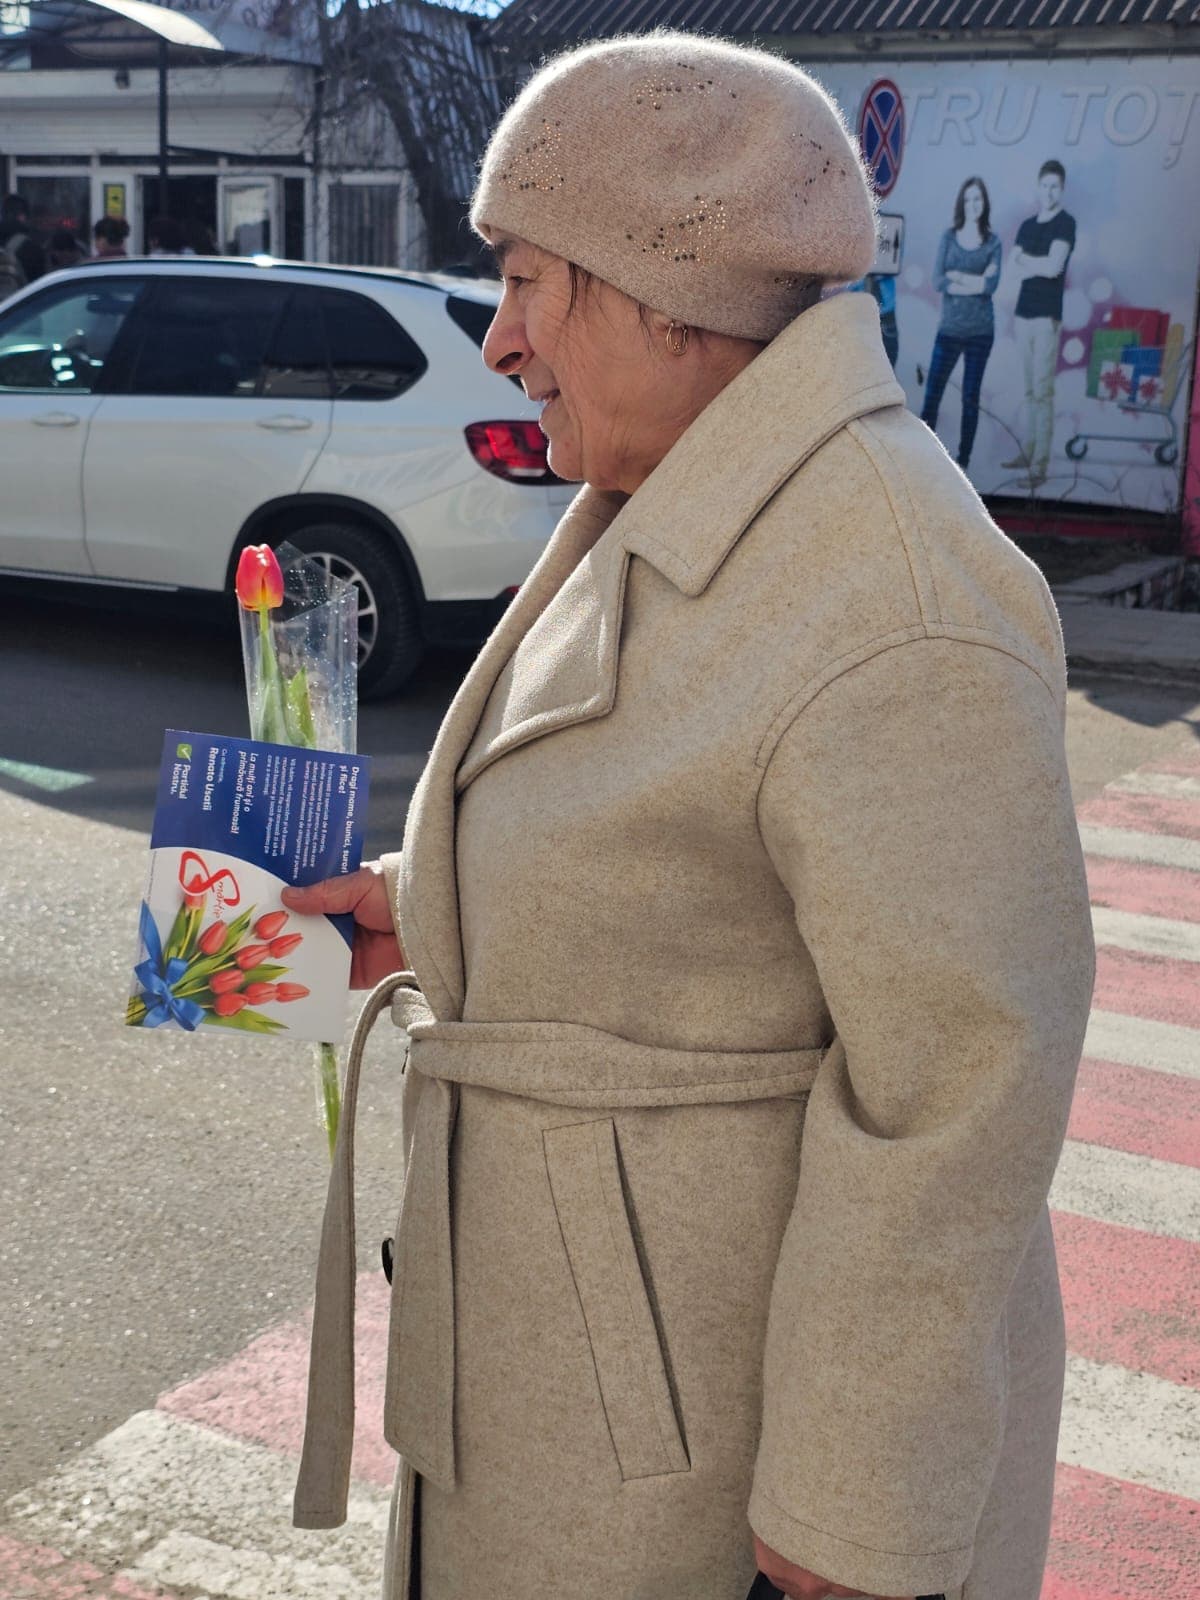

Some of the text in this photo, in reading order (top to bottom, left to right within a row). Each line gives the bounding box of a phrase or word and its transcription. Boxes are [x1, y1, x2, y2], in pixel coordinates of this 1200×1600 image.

[205, 746, 219, 782] Renato
[249, 752, 258, 762] La
[169, 763, 181, 795] Nostru.
[178, 764, 191, 799] Partidul
[230, 750, 248, 833] primăvară frumoasă!
[245, 784, 255, 797] ani
[338, 773, 347, 793] fiice!
[340, 766, 360, 873] Dragi mame, bunici, surori
[180, 851, 241, 907] 8
